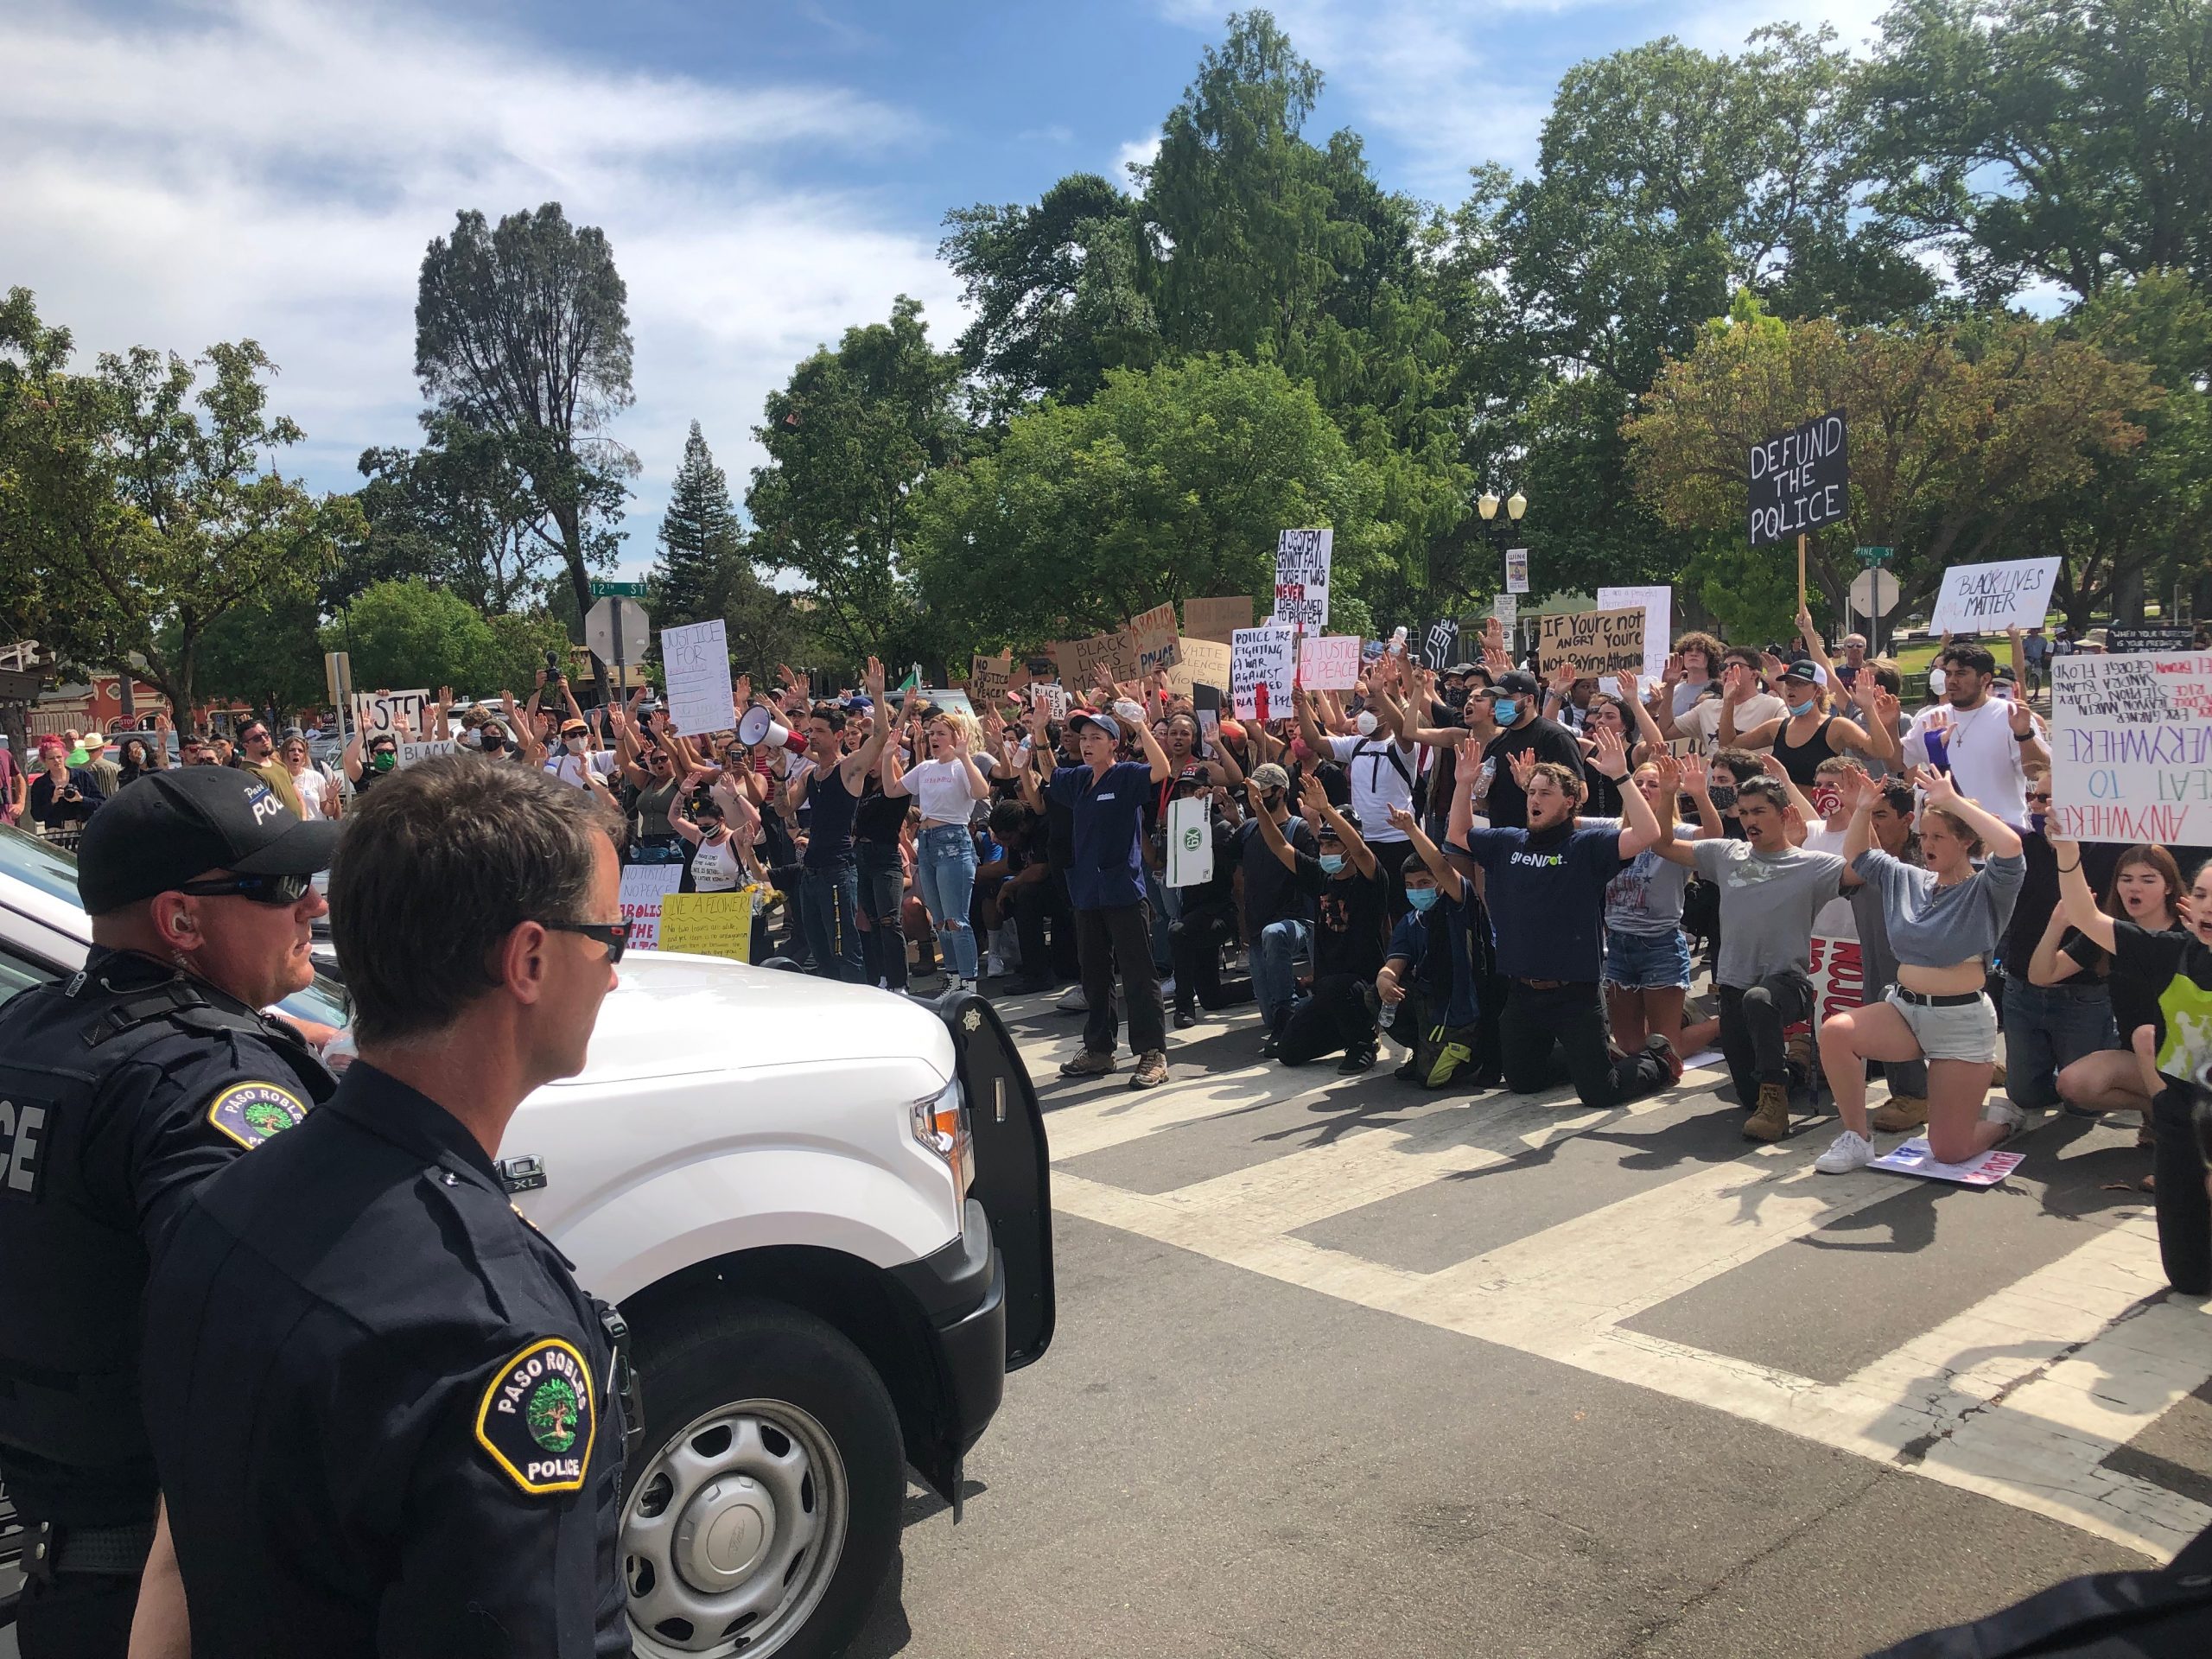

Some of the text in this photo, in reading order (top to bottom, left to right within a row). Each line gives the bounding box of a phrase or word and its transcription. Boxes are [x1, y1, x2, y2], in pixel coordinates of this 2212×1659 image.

[1751, 417, 1841, 480] DEFUND
[1773, 462, 1815, 497] THE
[1751, 485, 1840, 544] POLICE
[1279, 531, 1321, 551] A SYSTEM
[1278, 550, 1323, 569] CANNOT FAIL
[1885, 548, 1894, 556] ST
[1277, 569, 1325, 587] THOSE IT WAS
[1955, 569, 2044, 595] BLACK LIVES
[593, 583, 645, 594] 12TH ST
[1276, 584, 1306, 601] NEVER
[1280, 599, 1323, 612] DESIGNED
[1964, 592, 2016, 617] MATTER
[1277, 611, 1323, 624] TO PROTECT
[1544, 617, 1564, 638] IF
[1617, 611, 1645, 631] not
[664, 621, 723, 650] JUSTICE
[1440, 619, 1459, 636] BLM
[1276, 631, 1291, 642] ARE
[1556, 633, 1595, 649] ANGRY
[677, 645, 707, 665] FOR
[1077, 635, 1128, 658] BLACK
[1236, 645, 1282, 660] FIGHTING
[1318, 641, 1359, 659] JUSTICE
[976, 658, 988, 670] NO
[1078, 652, 1121, 672] LIVES
[1181, 658, 1226, 672] ILENCE
[1234, 658, 1267, 671] A WAR
[1318, 661, 1357, 678] PEACE
[2103, 660, 2155, 675] GEORGE
[977, 671, 1008, 685] JUSTICE
[1072, 662, 1136, 690] MATER
[1193, 668, 1205, 677] IS
[1236, 668, 1283, 683] AGAINST
[2054, 663, 2096, 680] FLOYD
[2053, 673, 2157, 693] SANDRA BLAND
[2055, 692, 2102, 704] CLARK
[2107, 684, 2169, 701] STEPHON
[2117, 712, 2159, 723] GARNER
[404, 743, 449, 760] BLACK
[2088, 769, 2212, 801] EAT TO
[2057, 804, 2190, 842] ANYWHERE
[623, 866, 678, 883] NO JUSTICE
[624, 884, 672, 898] NO PEACE
[664, 896, 750, 916] GIVE A FLOWER!
[629, 924, 654, 938] THE
[225, 1090, 304, 1124] PASO ROBLE
[513, 1179, 538, 1190] XL
[498, 1351, 587, 1414] PASO ROBLES
[528, 1459, 580, 1481] POLICE
